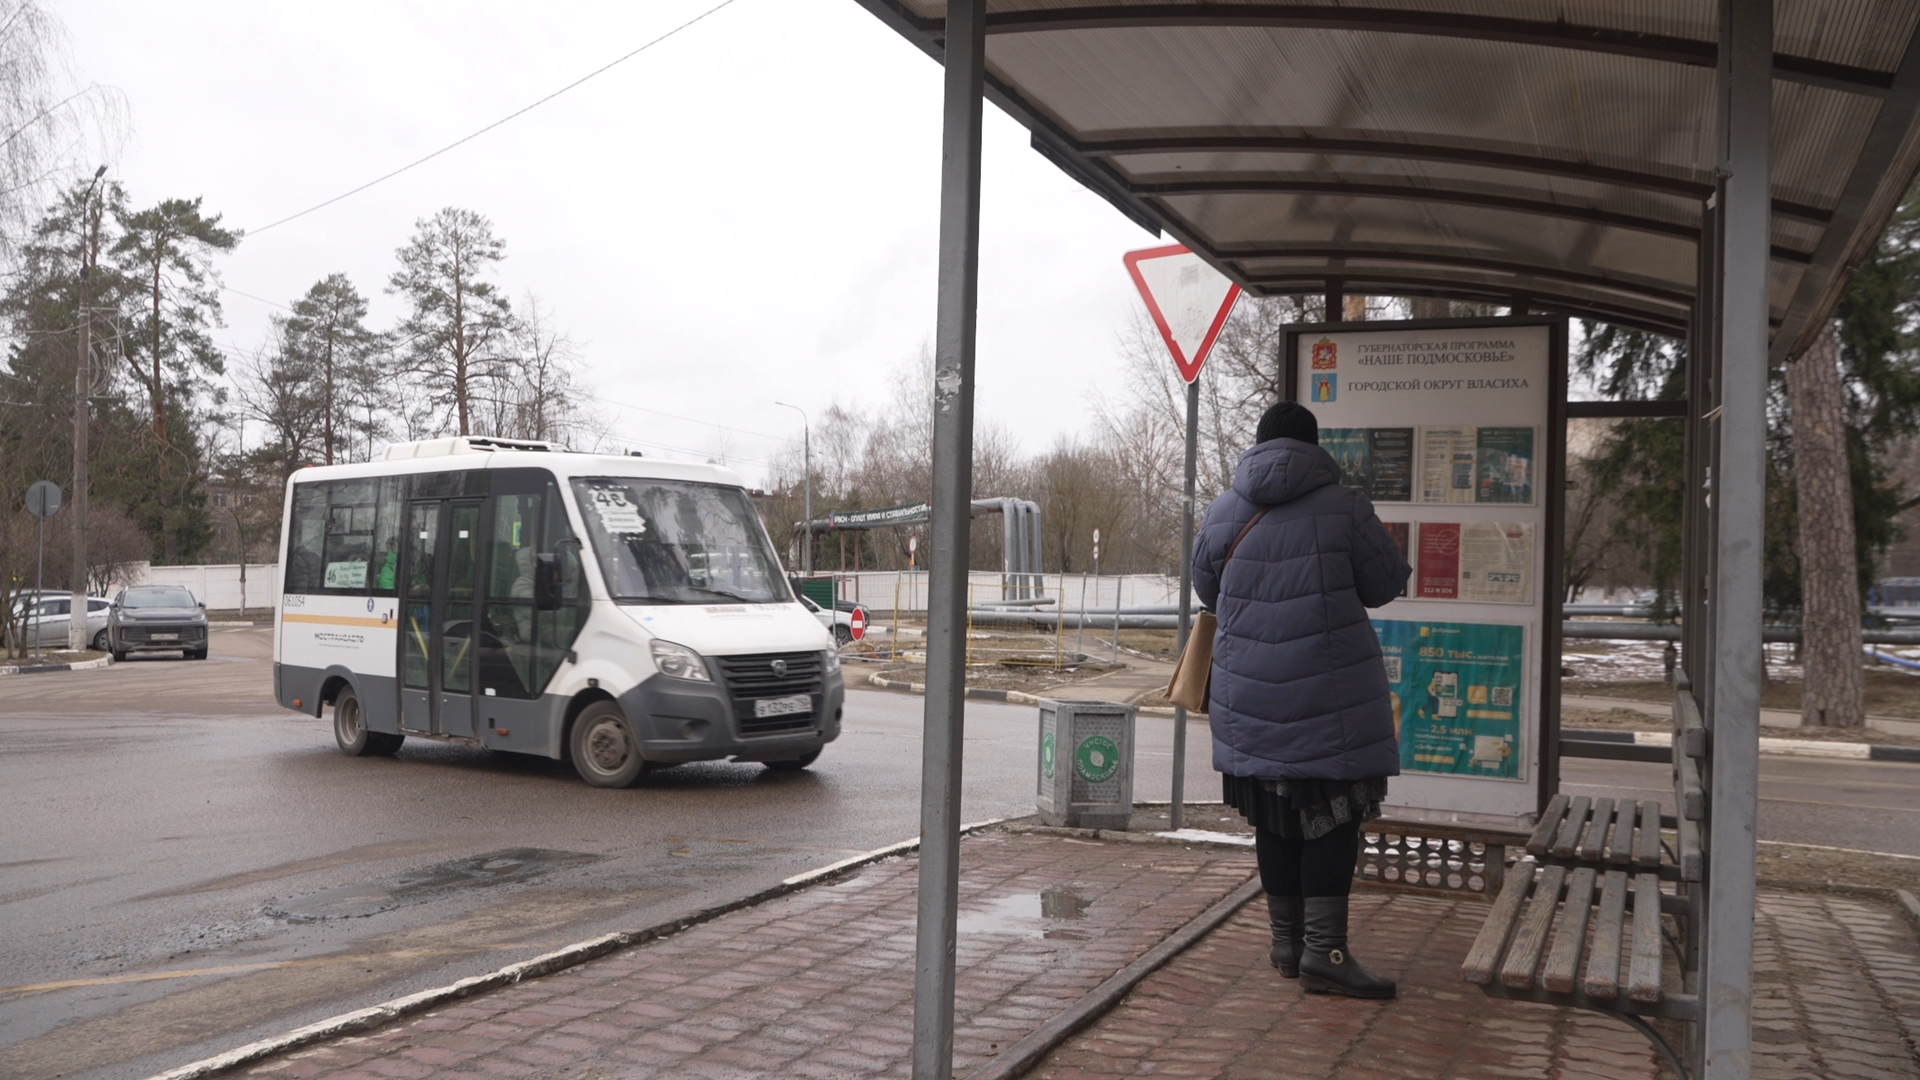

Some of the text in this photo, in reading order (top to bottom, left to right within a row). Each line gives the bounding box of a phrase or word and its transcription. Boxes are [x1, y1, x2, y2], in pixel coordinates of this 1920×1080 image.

[1357, 340, 1516, 354] ГУБЕРНАТОРСКАЯ ПРОГРАММА
[1358, 351, 1515, 367] «НАШЕ ПОДМОСКОВЬЕ»
[1348, 377, 1529, 392] ГОРОДСКОЙ ОКРУГ ВЛАСИХА
[851, 514, 866, 523] ОПЛОТ
[866, 512, 880, 521] МИРА
[326, 568, 337, 584] 46
[284, 595, 305, 607] 061054
[1419, 646, 1444, 658] 850
[1447, 649, 1476, 659] тыс.
[1431, 724, 1447, 734] 2,5
[1083, 738, 1113, 751] ЧИСТОЕ
[1076, 759, 1119, 781] ПОДМОСКОВЬЕ
